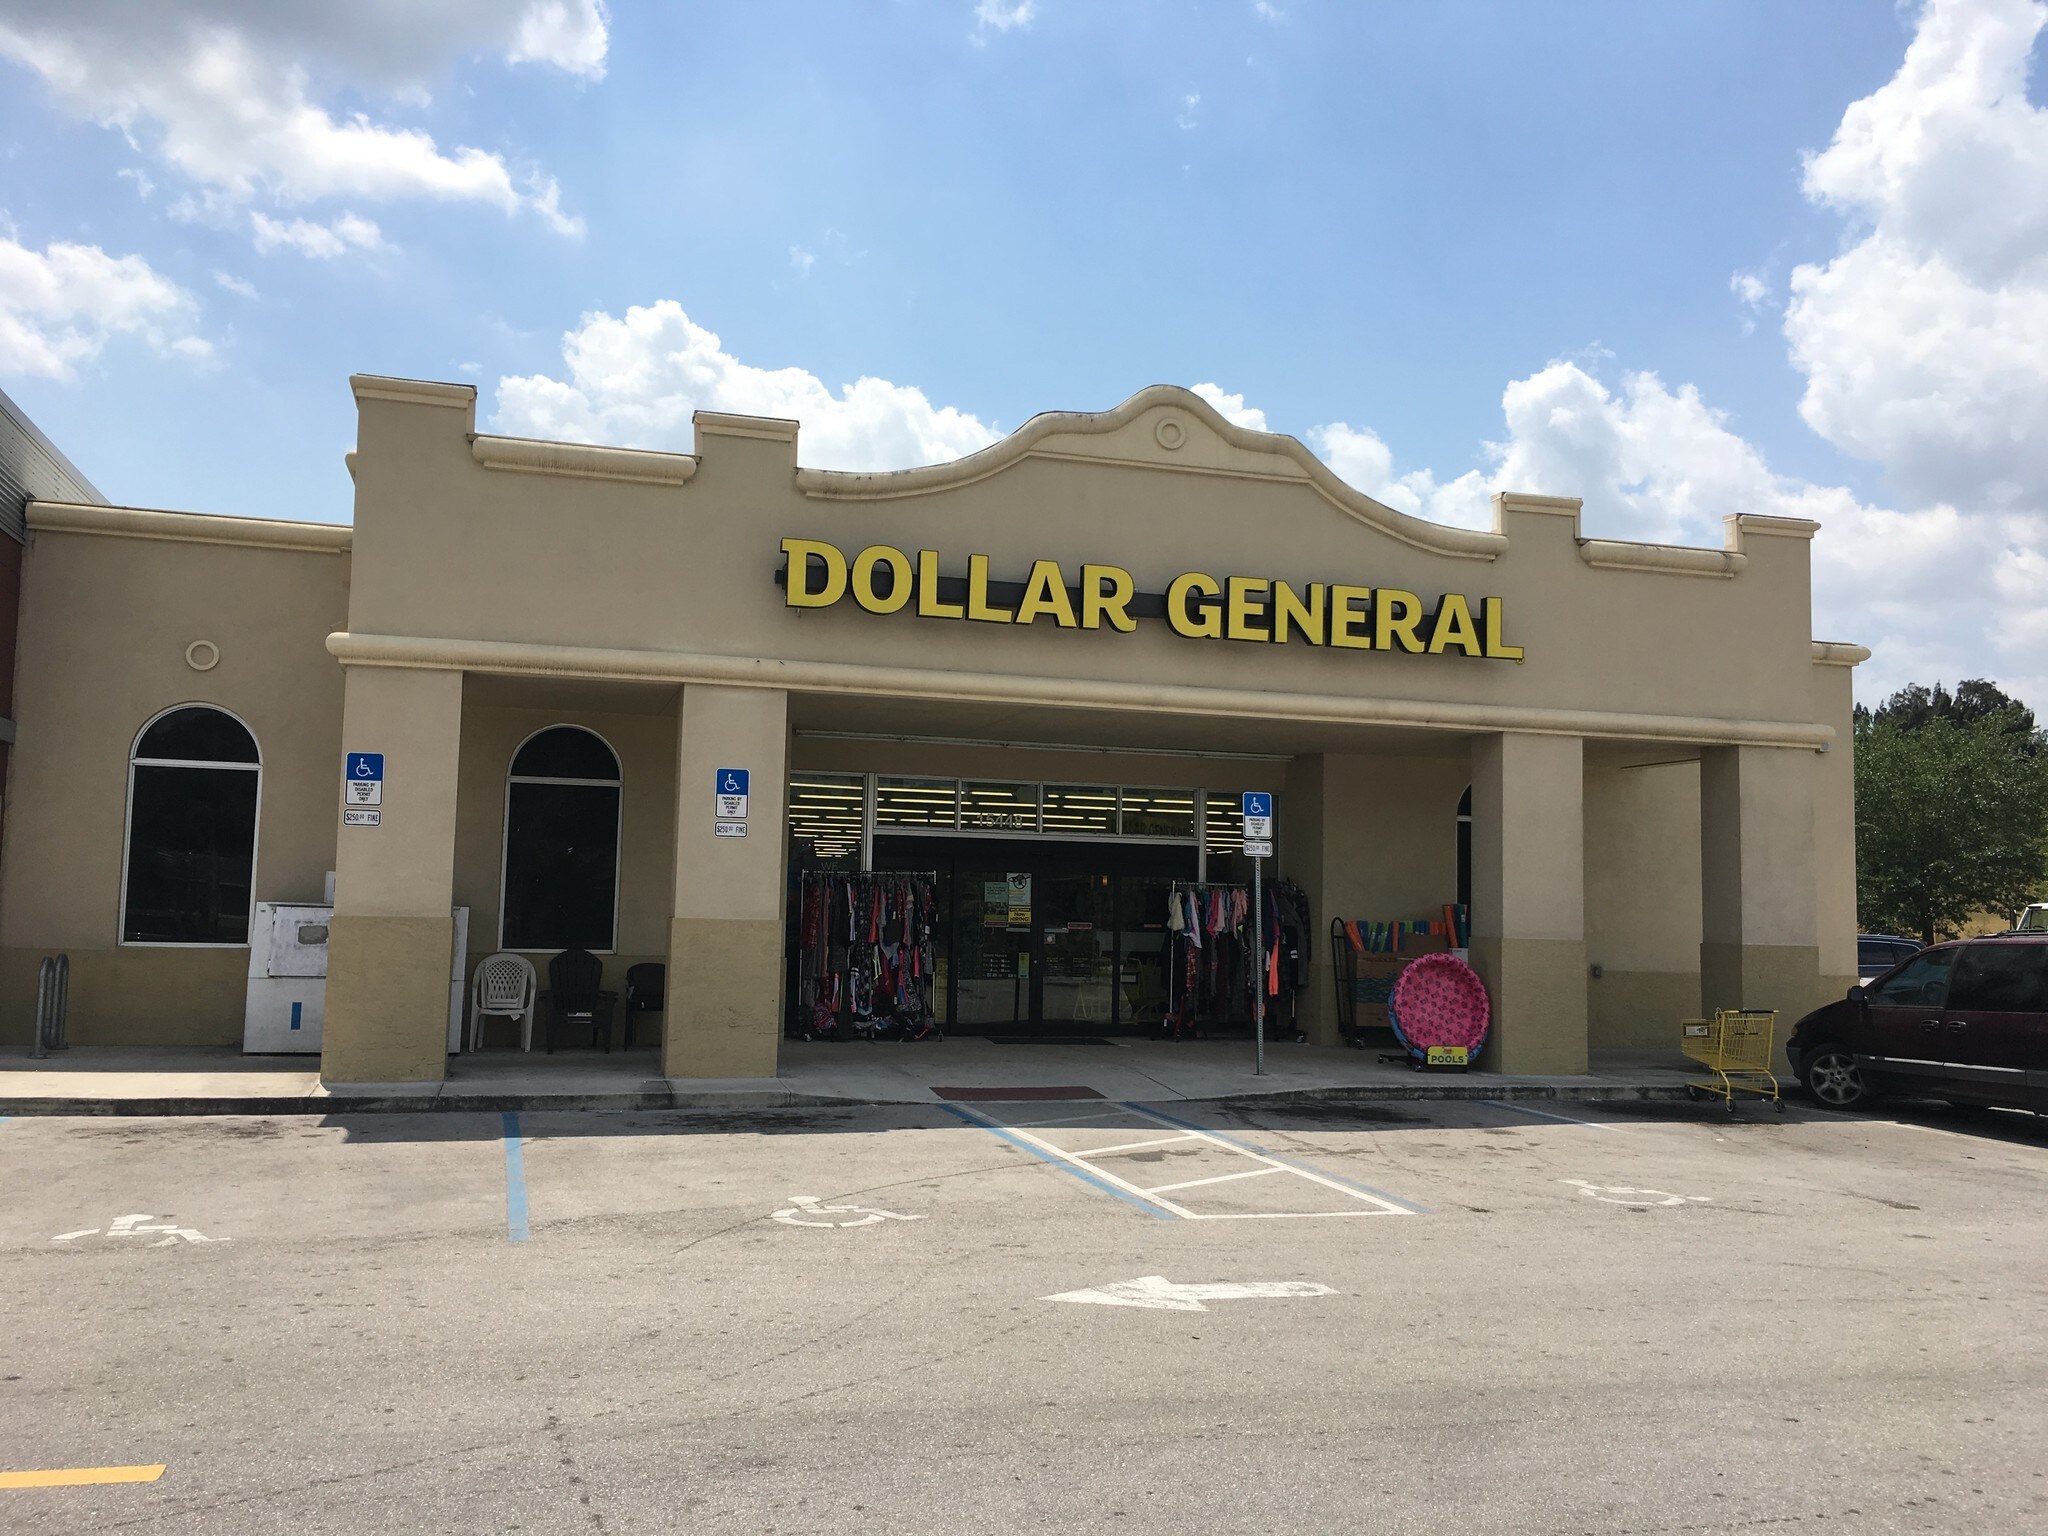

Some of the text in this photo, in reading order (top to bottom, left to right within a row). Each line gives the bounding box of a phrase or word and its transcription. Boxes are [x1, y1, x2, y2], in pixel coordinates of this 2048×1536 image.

[781, 537, 1524, 660] DOLLAR GENERAL
[367, 814, 379, 822] FINE
[976, 812, 1022, 828] 15448
[735, 826, 746, 834] FINE
[1431, 1055, 1464, 1064] POOLS
